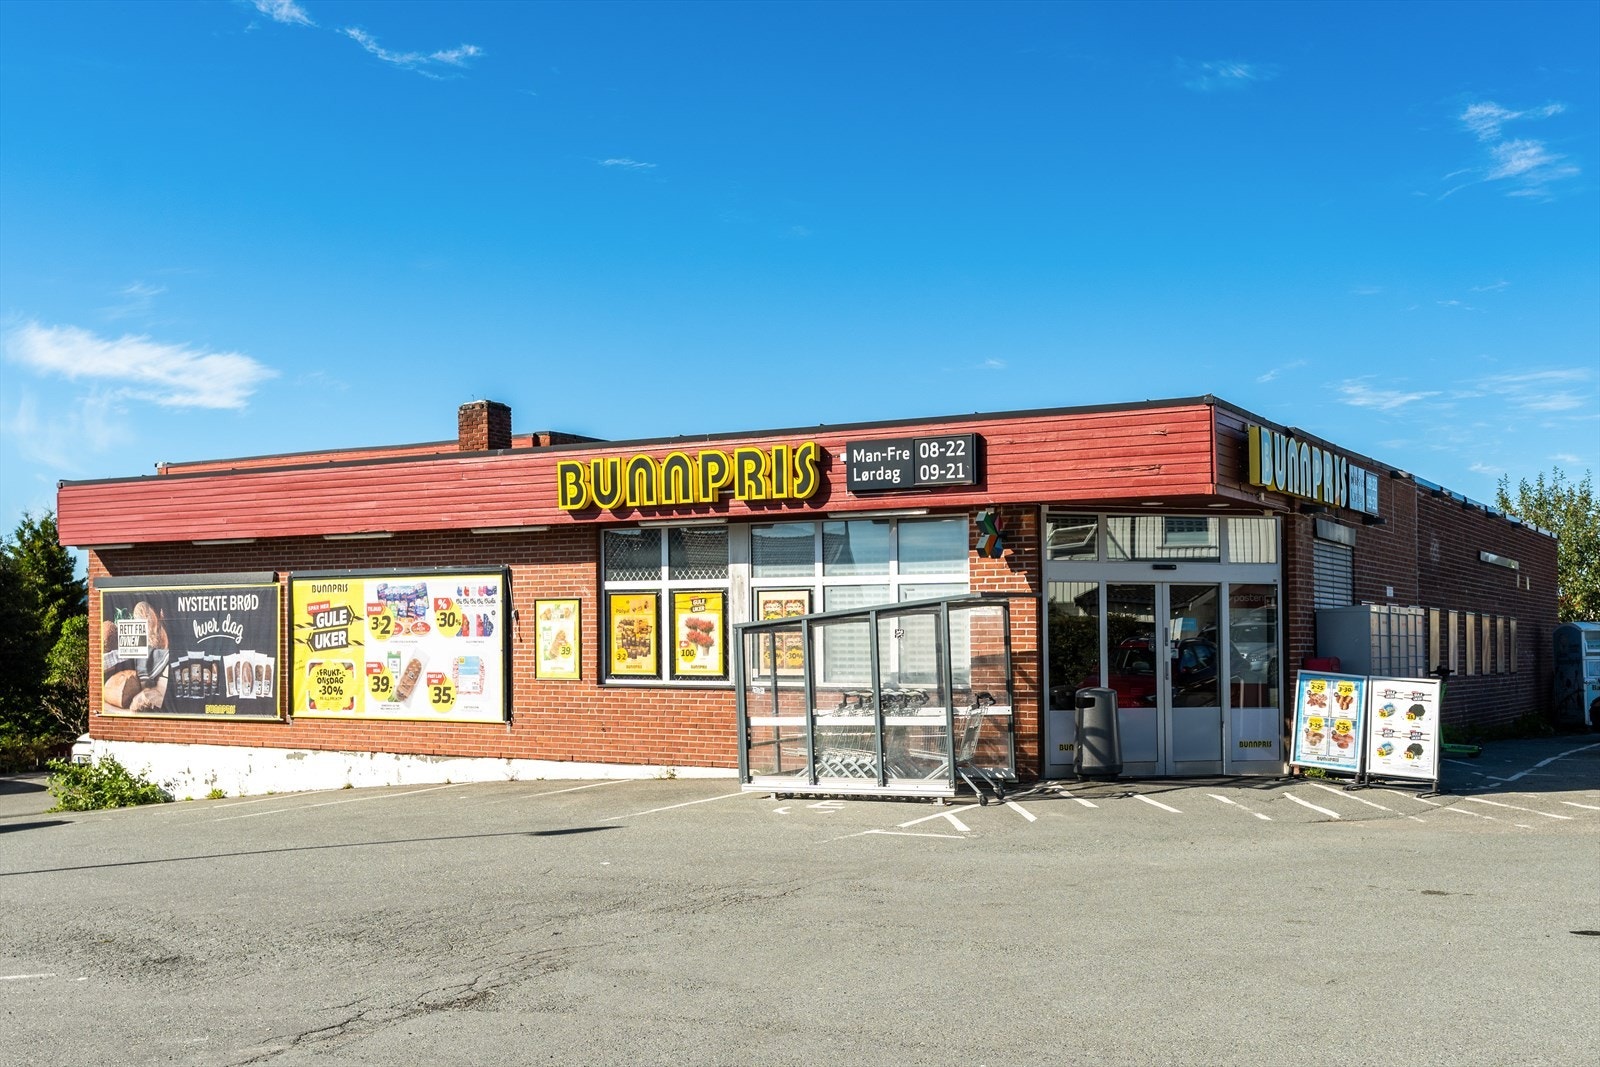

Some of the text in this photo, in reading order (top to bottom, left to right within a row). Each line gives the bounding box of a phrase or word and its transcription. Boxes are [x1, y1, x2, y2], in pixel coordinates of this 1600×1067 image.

[852, 440, 966, 463] Man-Fre 08-22
[557, 441, 821, 510] BUNNPRIS
[852, 463, 966, 484] Lørdag 09-21
[1259, 427, 1347, 508] BUNNPRIS
[311, 583, 349, 593] BUNNPRIS
[177, 594, 259, 612] NYSTEKTE BRØD
[315, 609, 348, 628] GULE
[371, 616, 379, 630] 3
[380, 615, 392, 634] 2
[119, 624, 147, 634] RETT FRA
[192, 613, 244, 644] hver dag
[314, 630, 347, 649] UKER
[316, 677, 344, 685] ONSDAG
[318, 685, 344, 696] -30%
